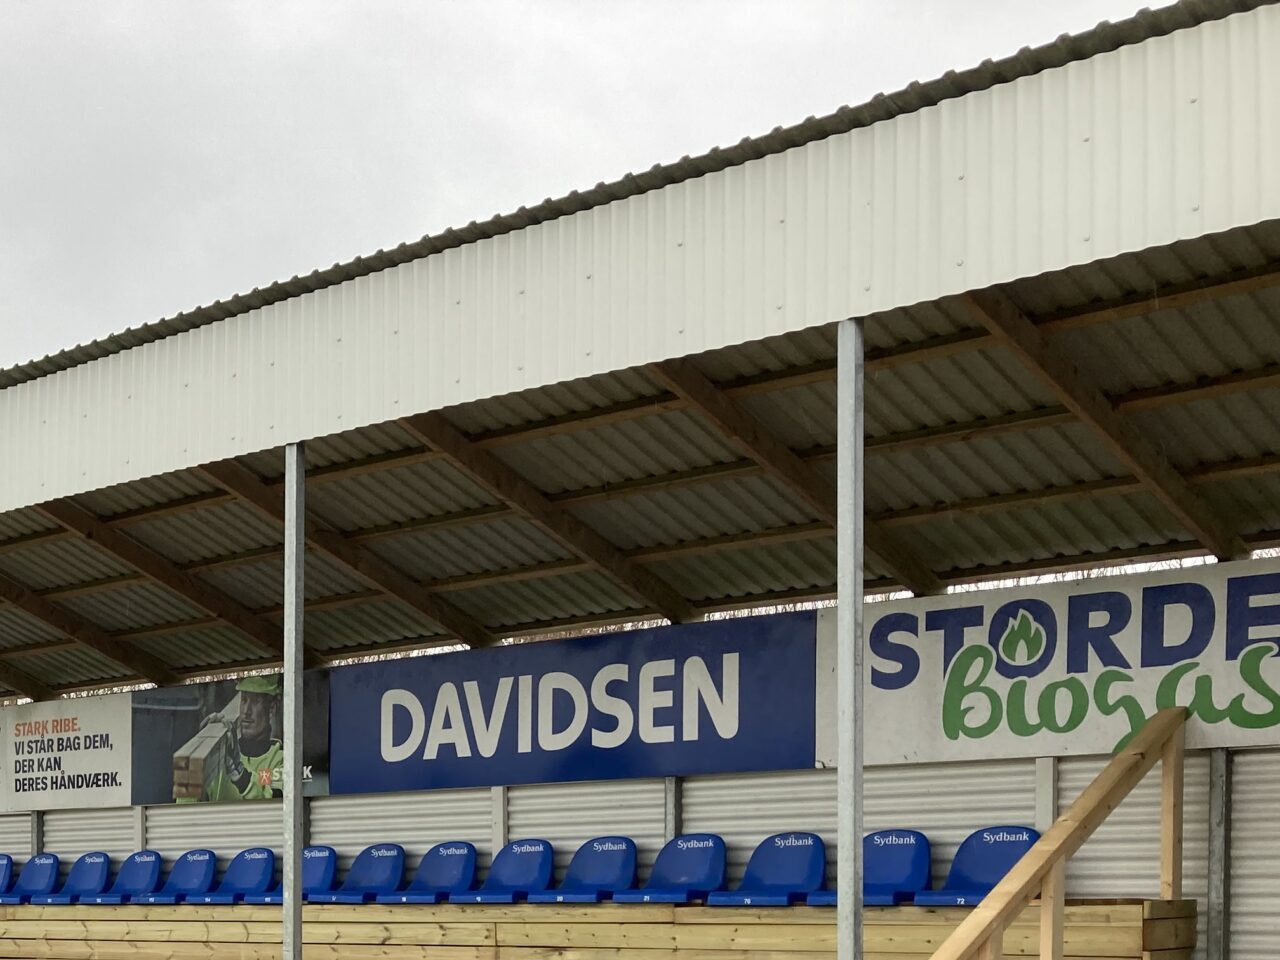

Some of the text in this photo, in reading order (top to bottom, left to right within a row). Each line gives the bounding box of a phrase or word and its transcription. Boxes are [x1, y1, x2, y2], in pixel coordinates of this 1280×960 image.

[380, 652, 739, 763] DAVIDSEN
[15, 717, 81, 737] STARK RIBE.
[15, 733, 113, 755] VI STÅR BAG DEM,
[15, 756, 61, 774] DER KAN
[15, 770, 122, 792] DERES HÅNDVÆRK.
[775, 836, 813, 848] Sydbank
[874, 835, 916, 847] Sydbank
[983, 832, 1029, 843] Sydbank
[512, 844, 544, 854] Sydbank
[593, 842, 627, 853] Sydbank
[678, 839, 714, 849] Sydbank
[439, 846, 469, 856] Sydbank
